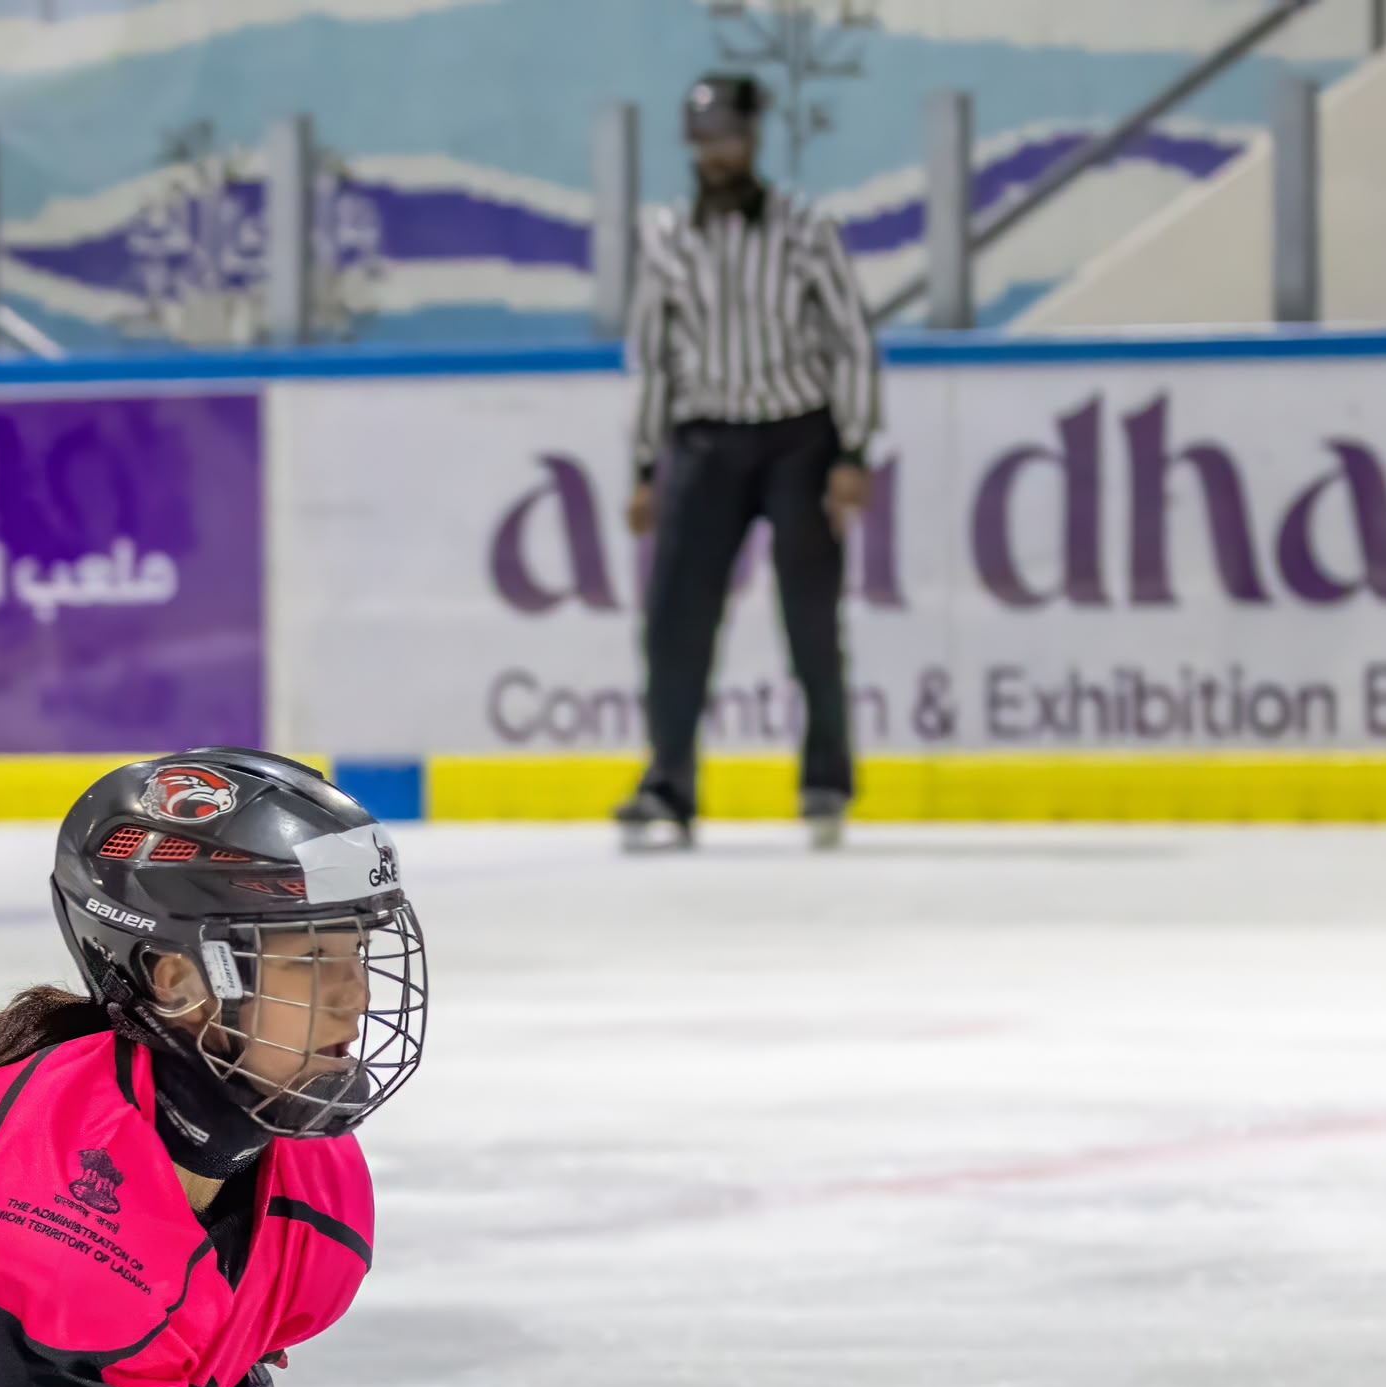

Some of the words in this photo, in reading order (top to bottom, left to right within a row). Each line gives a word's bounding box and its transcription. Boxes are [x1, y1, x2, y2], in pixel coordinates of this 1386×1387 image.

[15, 537, 178, 622] ملعب
[488, 668, 889, 742] Conntin
[910, 667, 956, 742] &
[985, 662, 1338, 739] Exhibition
[7, 1198, 32, 1212] THE
[29, 1206, 130, 1263] ADMINISTRATION
[131, 1258, 145, 1272] OF
[29, 1219, 93, 1255] TERRITORY
[94, 1250, 111, 1264] OF
